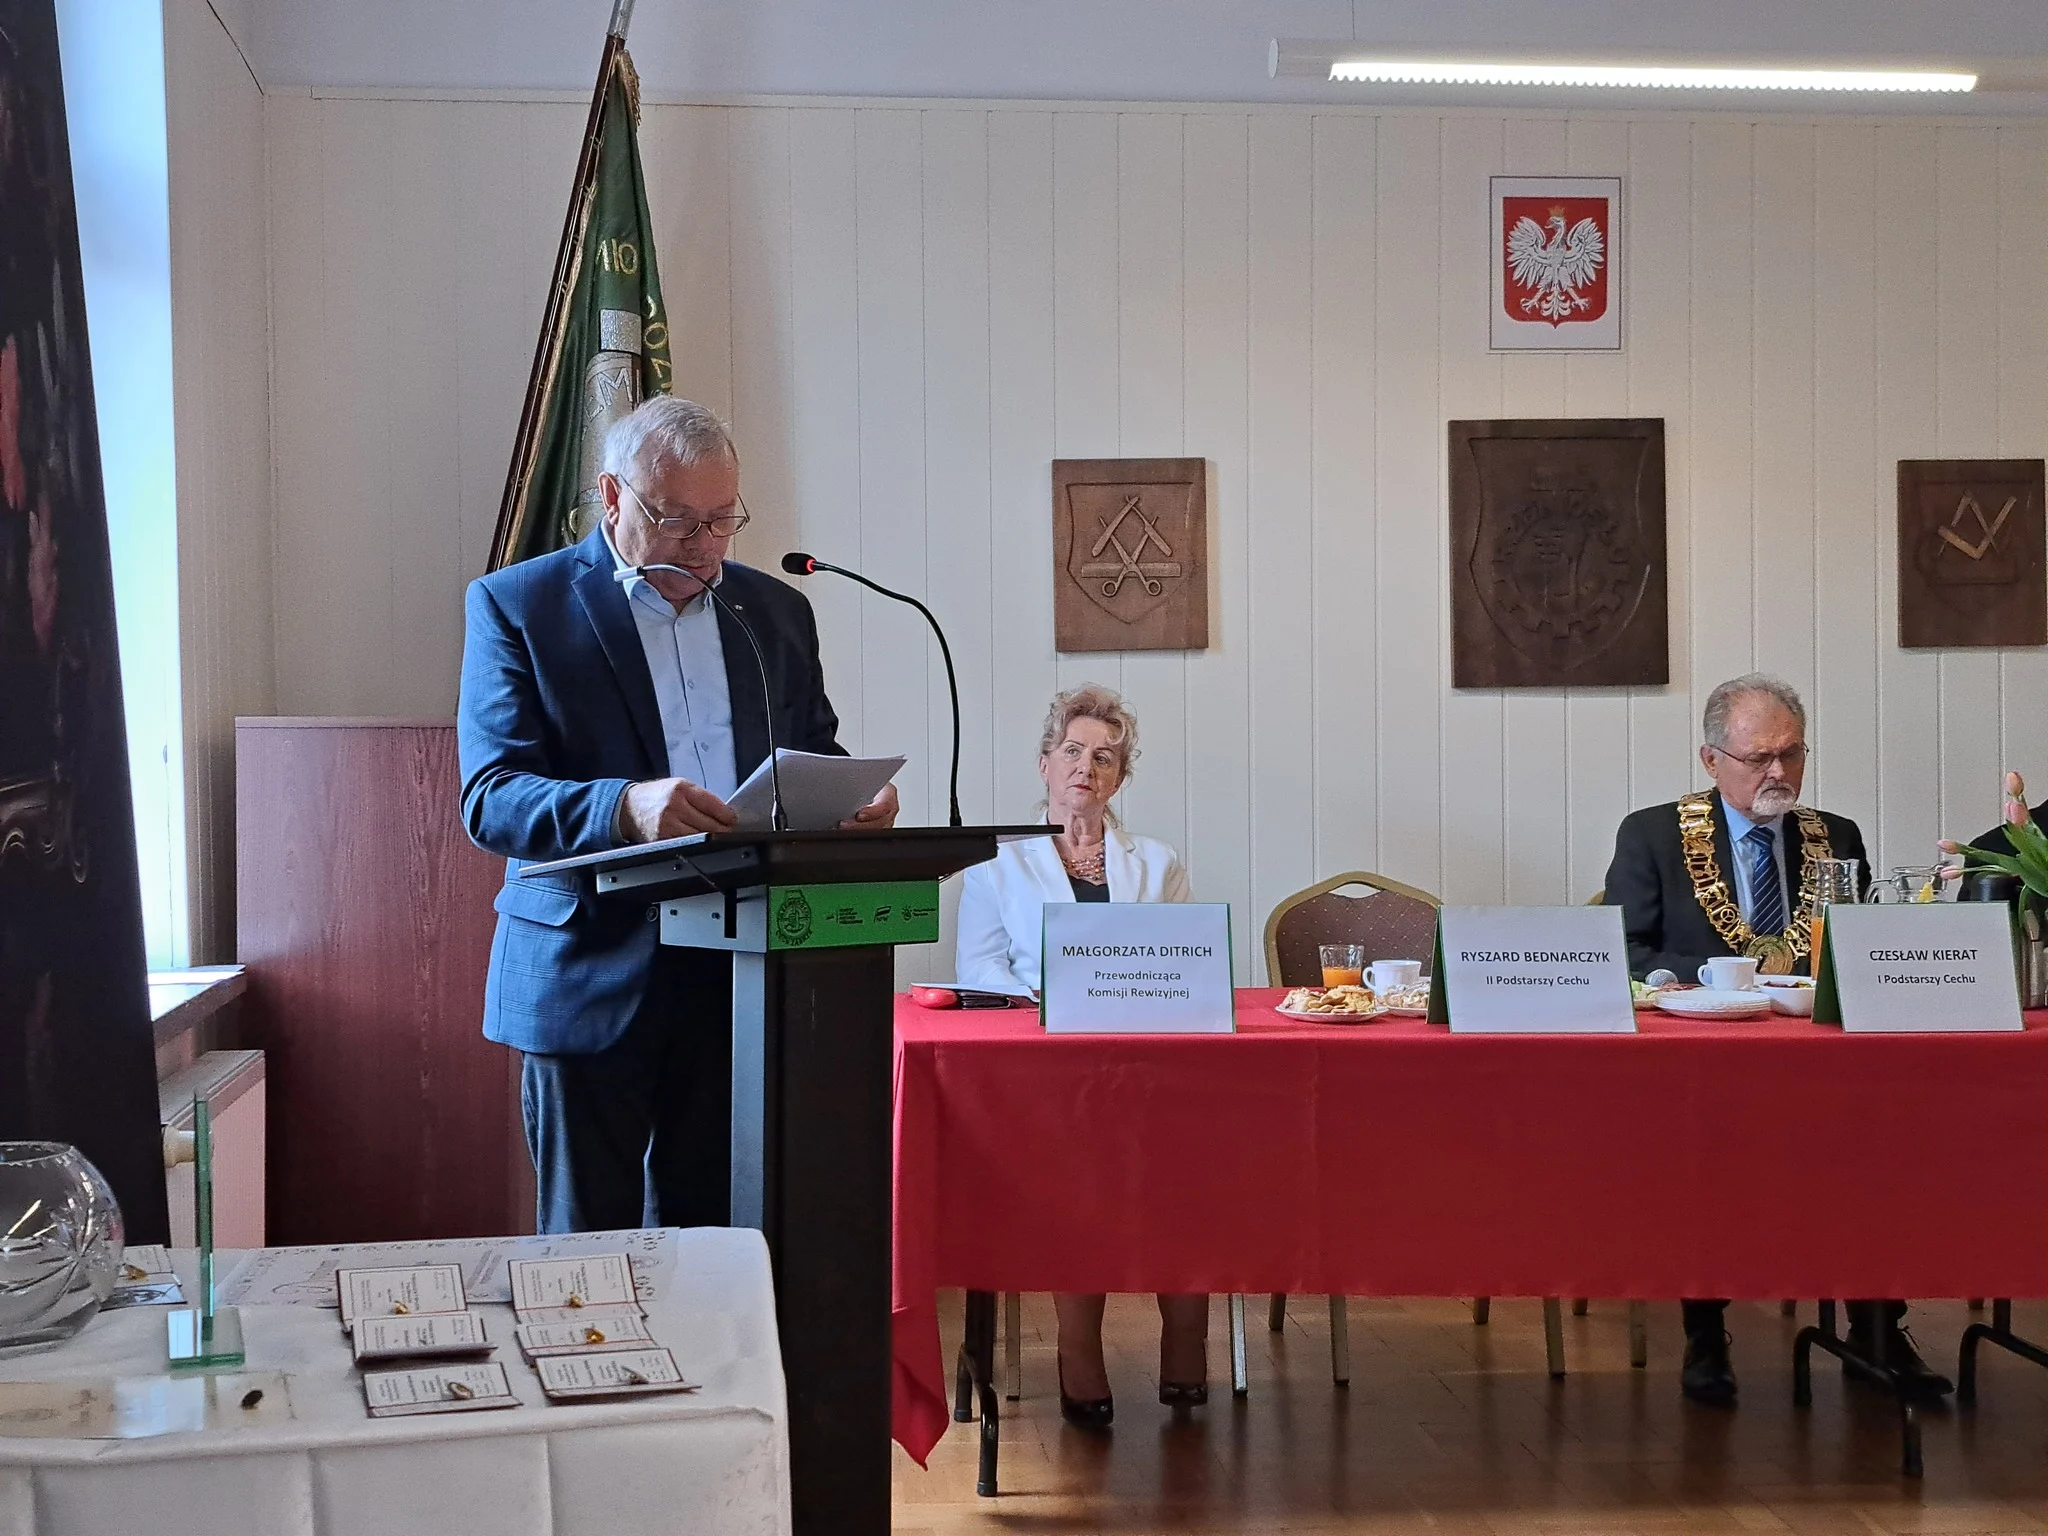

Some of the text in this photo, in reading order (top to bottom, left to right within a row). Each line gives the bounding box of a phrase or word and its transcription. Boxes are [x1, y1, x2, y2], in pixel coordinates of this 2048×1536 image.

[1062, 945, 1212, 958] MAŁGORZATA DITRICH
[1460, 951, 1611, 963] RYSZARD BEDNARCZYK
[1869, 949, 1979, 962] CZESŁAW KIERAT
[1094, 970, 1181, 983] Przewodnicząca
[1495, 975, 1554, 988] Podstarszy
[1556, 975, 1590, 986] Cechu
[1883, 974, 1941, 986] Podstarszy
[1943, 973, 1976, 984] Cechu
[1087, 987, 1190, 1000] Komisji Rewizyjnej
